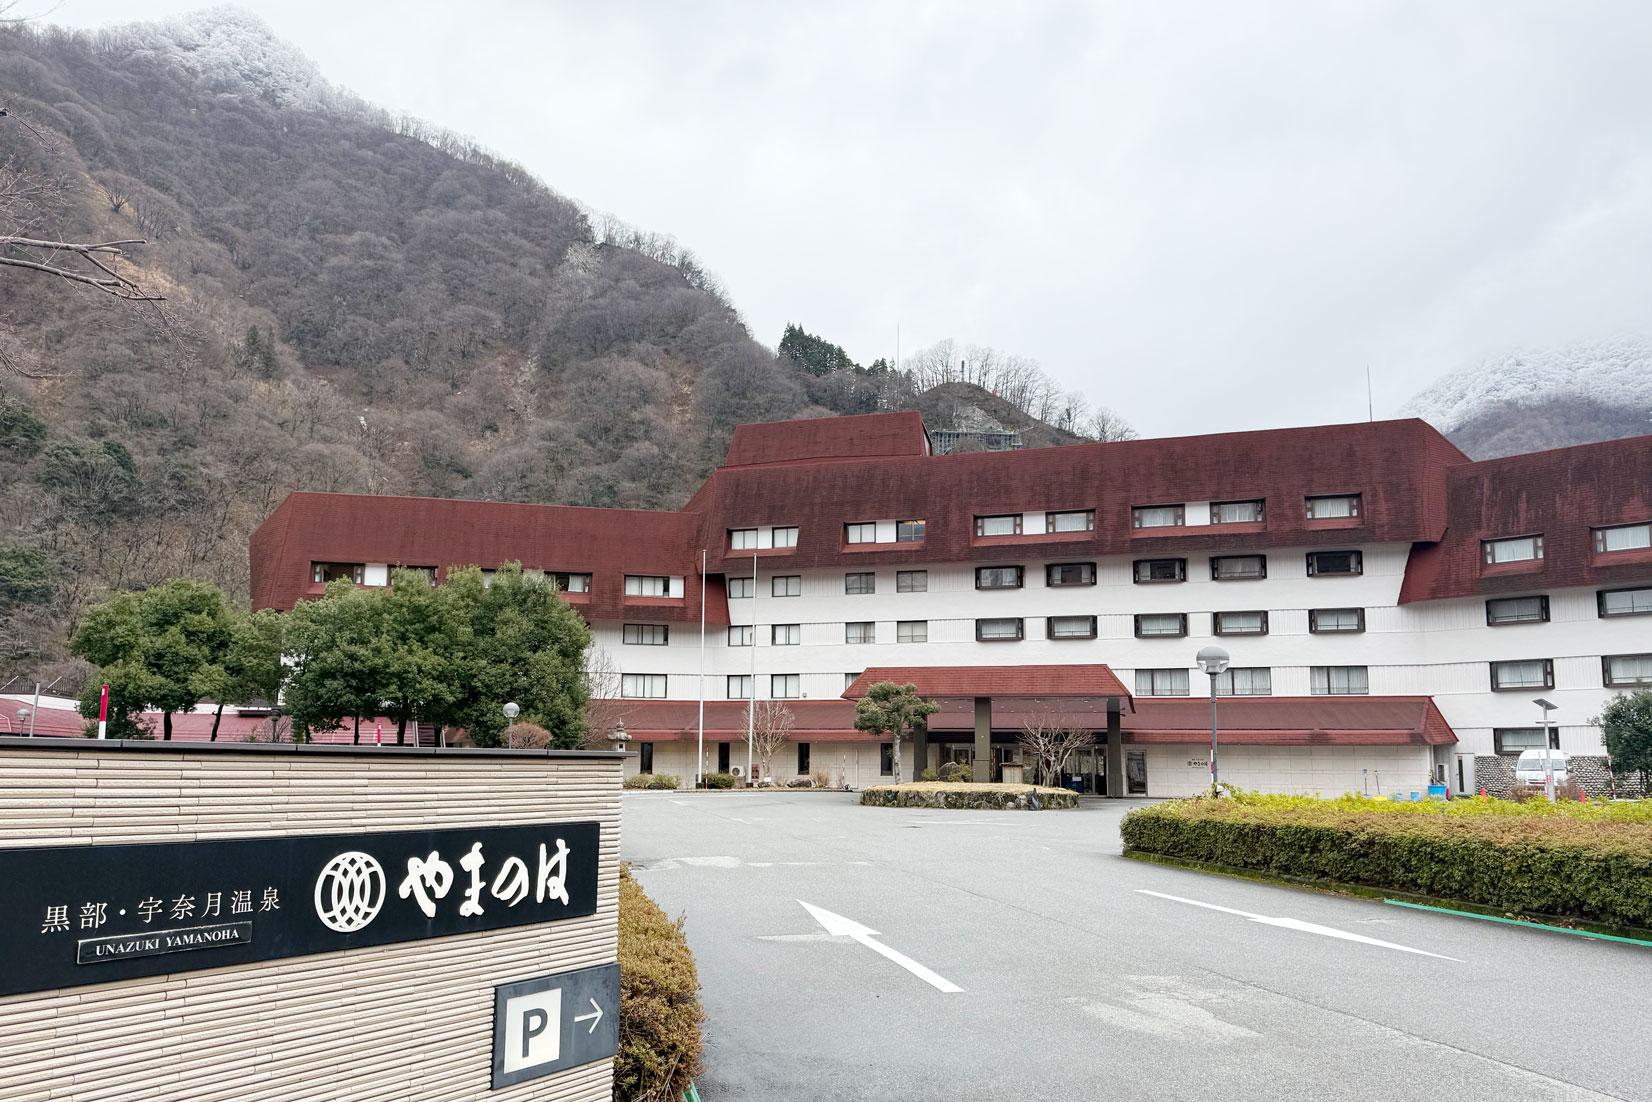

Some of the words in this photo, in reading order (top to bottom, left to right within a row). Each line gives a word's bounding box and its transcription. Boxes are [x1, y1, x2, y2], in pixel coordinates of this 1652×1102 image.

[399, 838, 571, 918] やまのは
[96, 939, 160, 956] UNAZUKI
[166, 928, 240, 947] YAMANOHA
[522, 1007, 549, 1059] P
